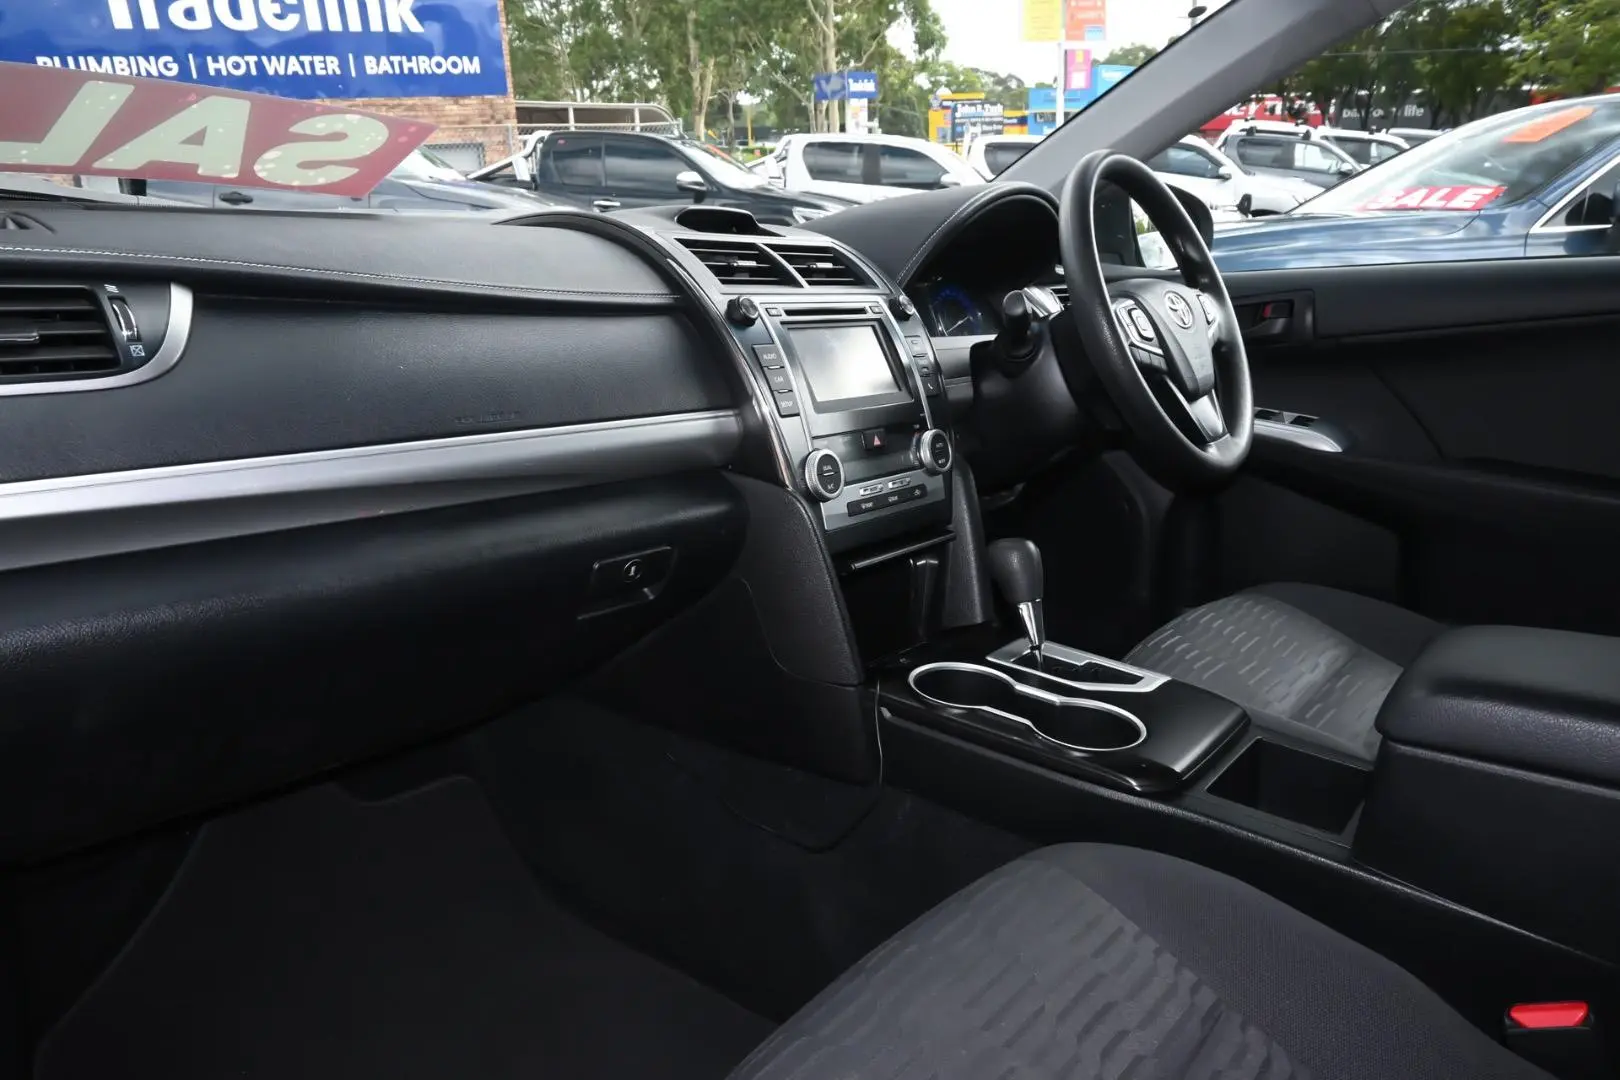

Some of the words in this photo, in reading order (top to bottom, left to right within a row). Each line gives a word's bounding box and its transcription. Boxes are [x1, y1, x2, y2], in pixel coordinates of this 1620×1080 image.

[207, 55, 258, 76] HOT
[261, 56, 342, 76] WATER
[364, 56, 481, 75] BATHROOM
[1367, 187, 1496, 209] SALE
